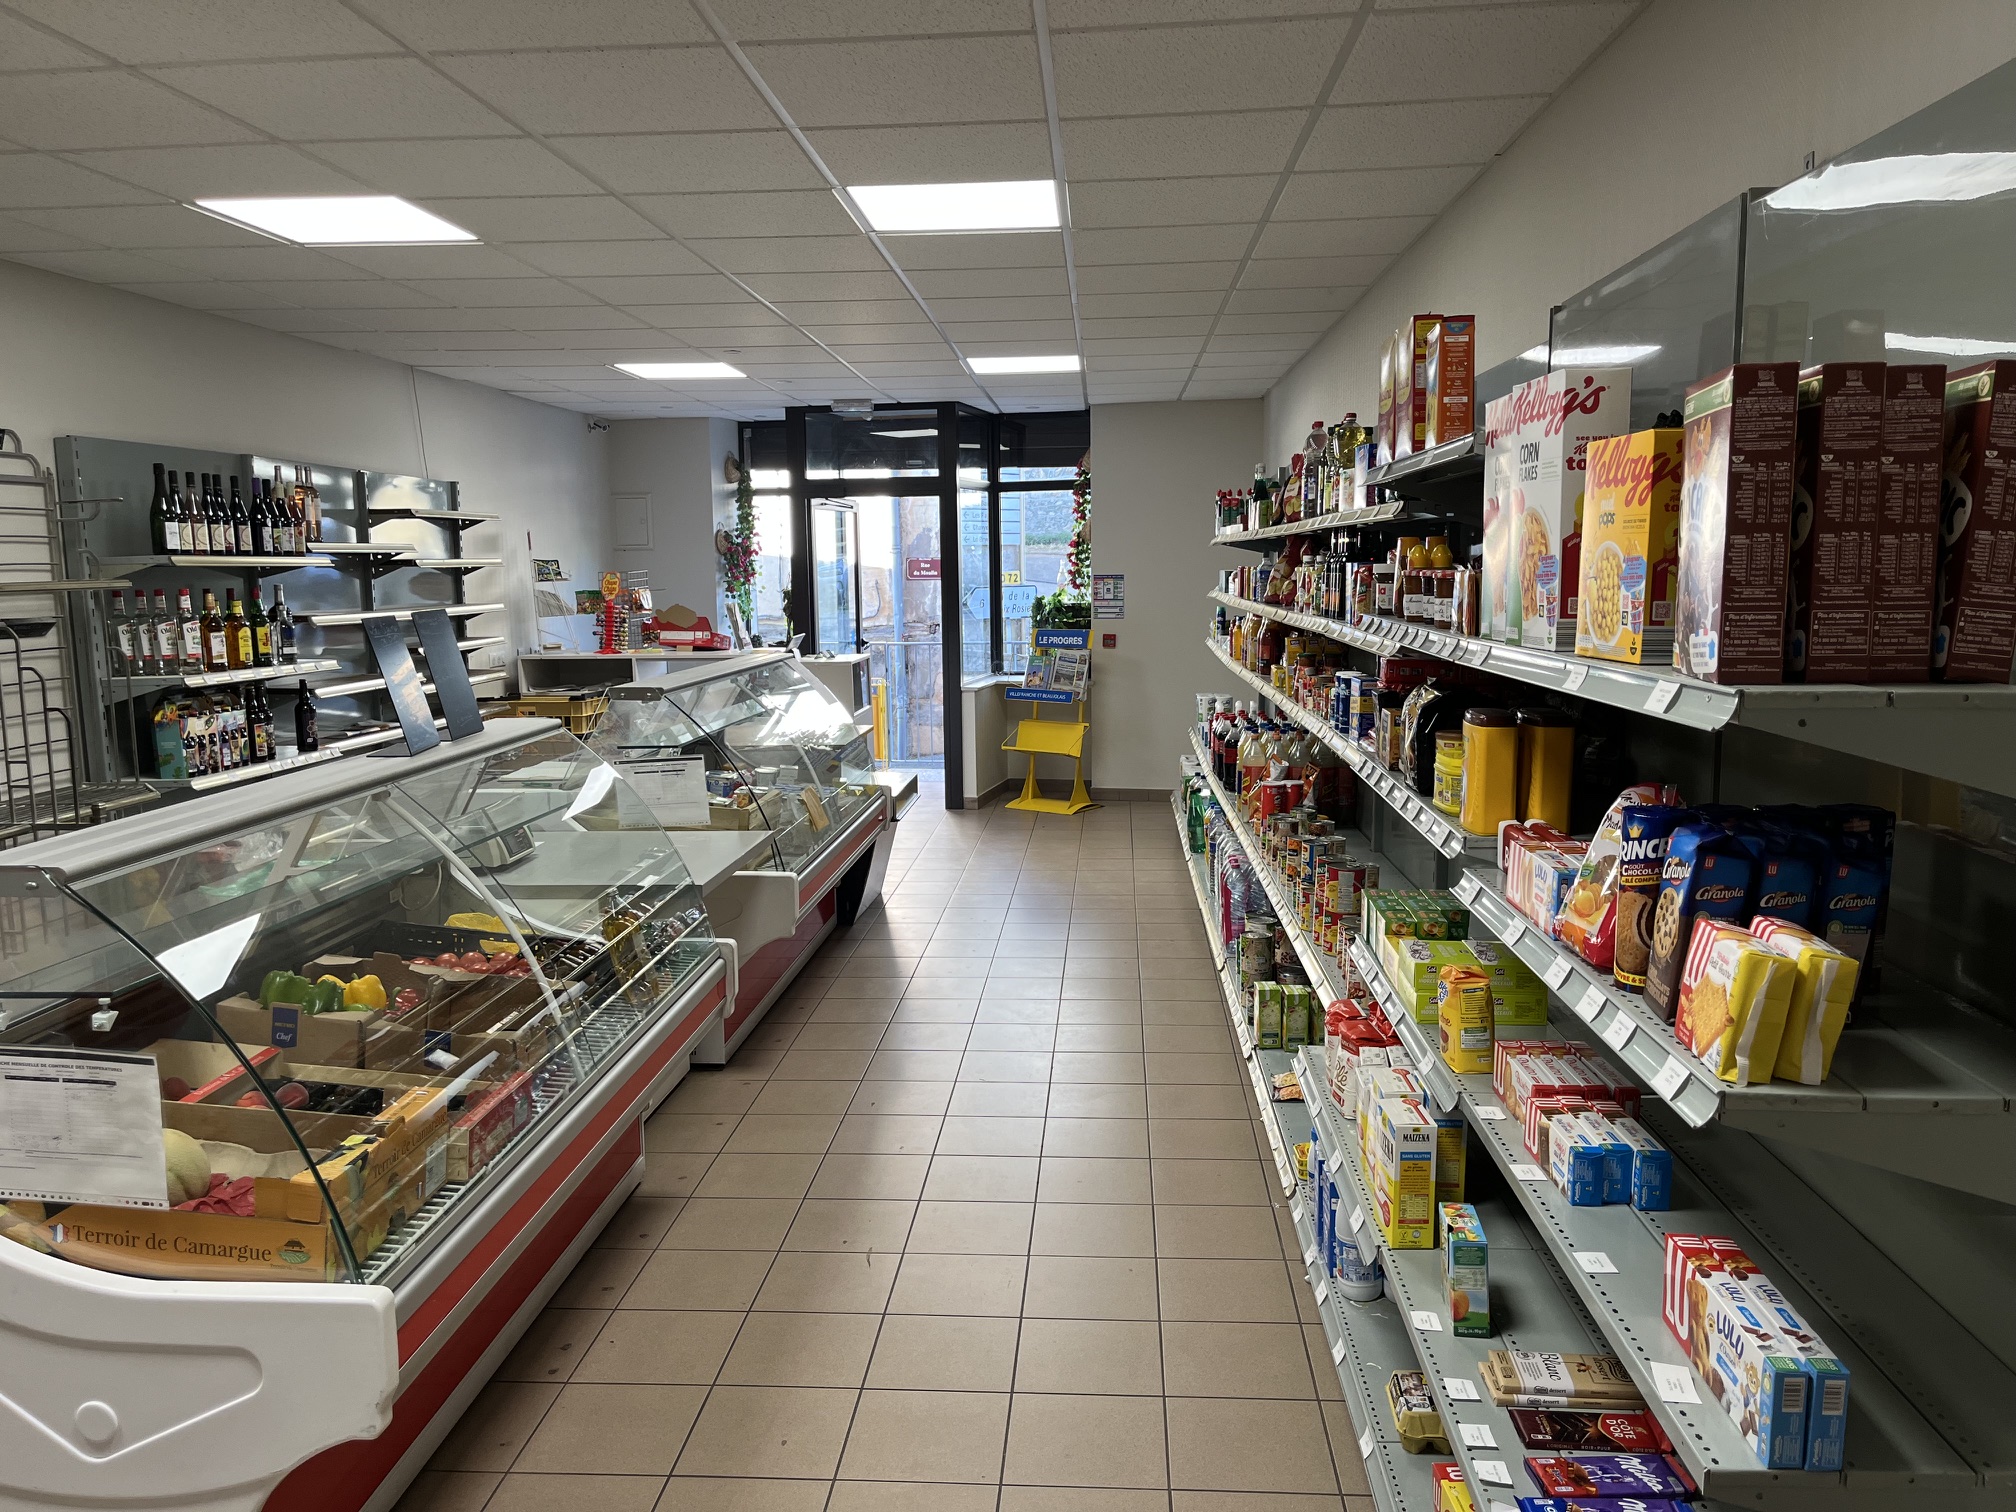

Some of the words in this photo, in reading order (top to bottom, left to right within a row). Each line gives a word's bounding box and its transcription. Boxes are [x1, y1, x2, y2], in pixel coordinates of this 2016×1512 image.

[1511, 374, 1606, 438] Kellogg's
[1520, 441, 1540, 465] CORN
[1520, 465, 1538, 482] FLAKES
[1599, 512, 1615, 529] pops
[1008, 574, 1018, 582] 72
[1009, 590, 1018, 599] de
[1022, 590, 1030, 599] la
[1012, 604, 1031, 614] Rosie
[1662, 858, 1690, 880] Granola
[1705, 858, 1714, 868] LU
[1768, 865, 1777, 874] LU
[1839, 867, 1848, 876] LU
[1695, 885, 1744, 900] Granola
[1760, 892, 1806, 908] Granola
[1830, 894, 1876, 910] Granola
[276, 1032, 292, 1042] Chef
[1403, 1134, 1430, 1142] MAIZENA
[72, 1224, 141, 1248] Terroir
[145, 1233, 168, 1251] de
[173, 1236, 272, 1263] Camargue
[1665, 1238, 1696, 1342] LU
[1719, 1283, 1746, 1303] LULU
[1756, 1285, 1784, 1304] LULU
[1716, 1310, 1744, 1360] LULU
[1538, 1353, 1561, 1381] Blanc
[1606, 1419, 1623, 1438] D'OR
[1618, 1419, 1636, 1439] CÔTE
[1614, 1456, 1663, 1494] Milka
